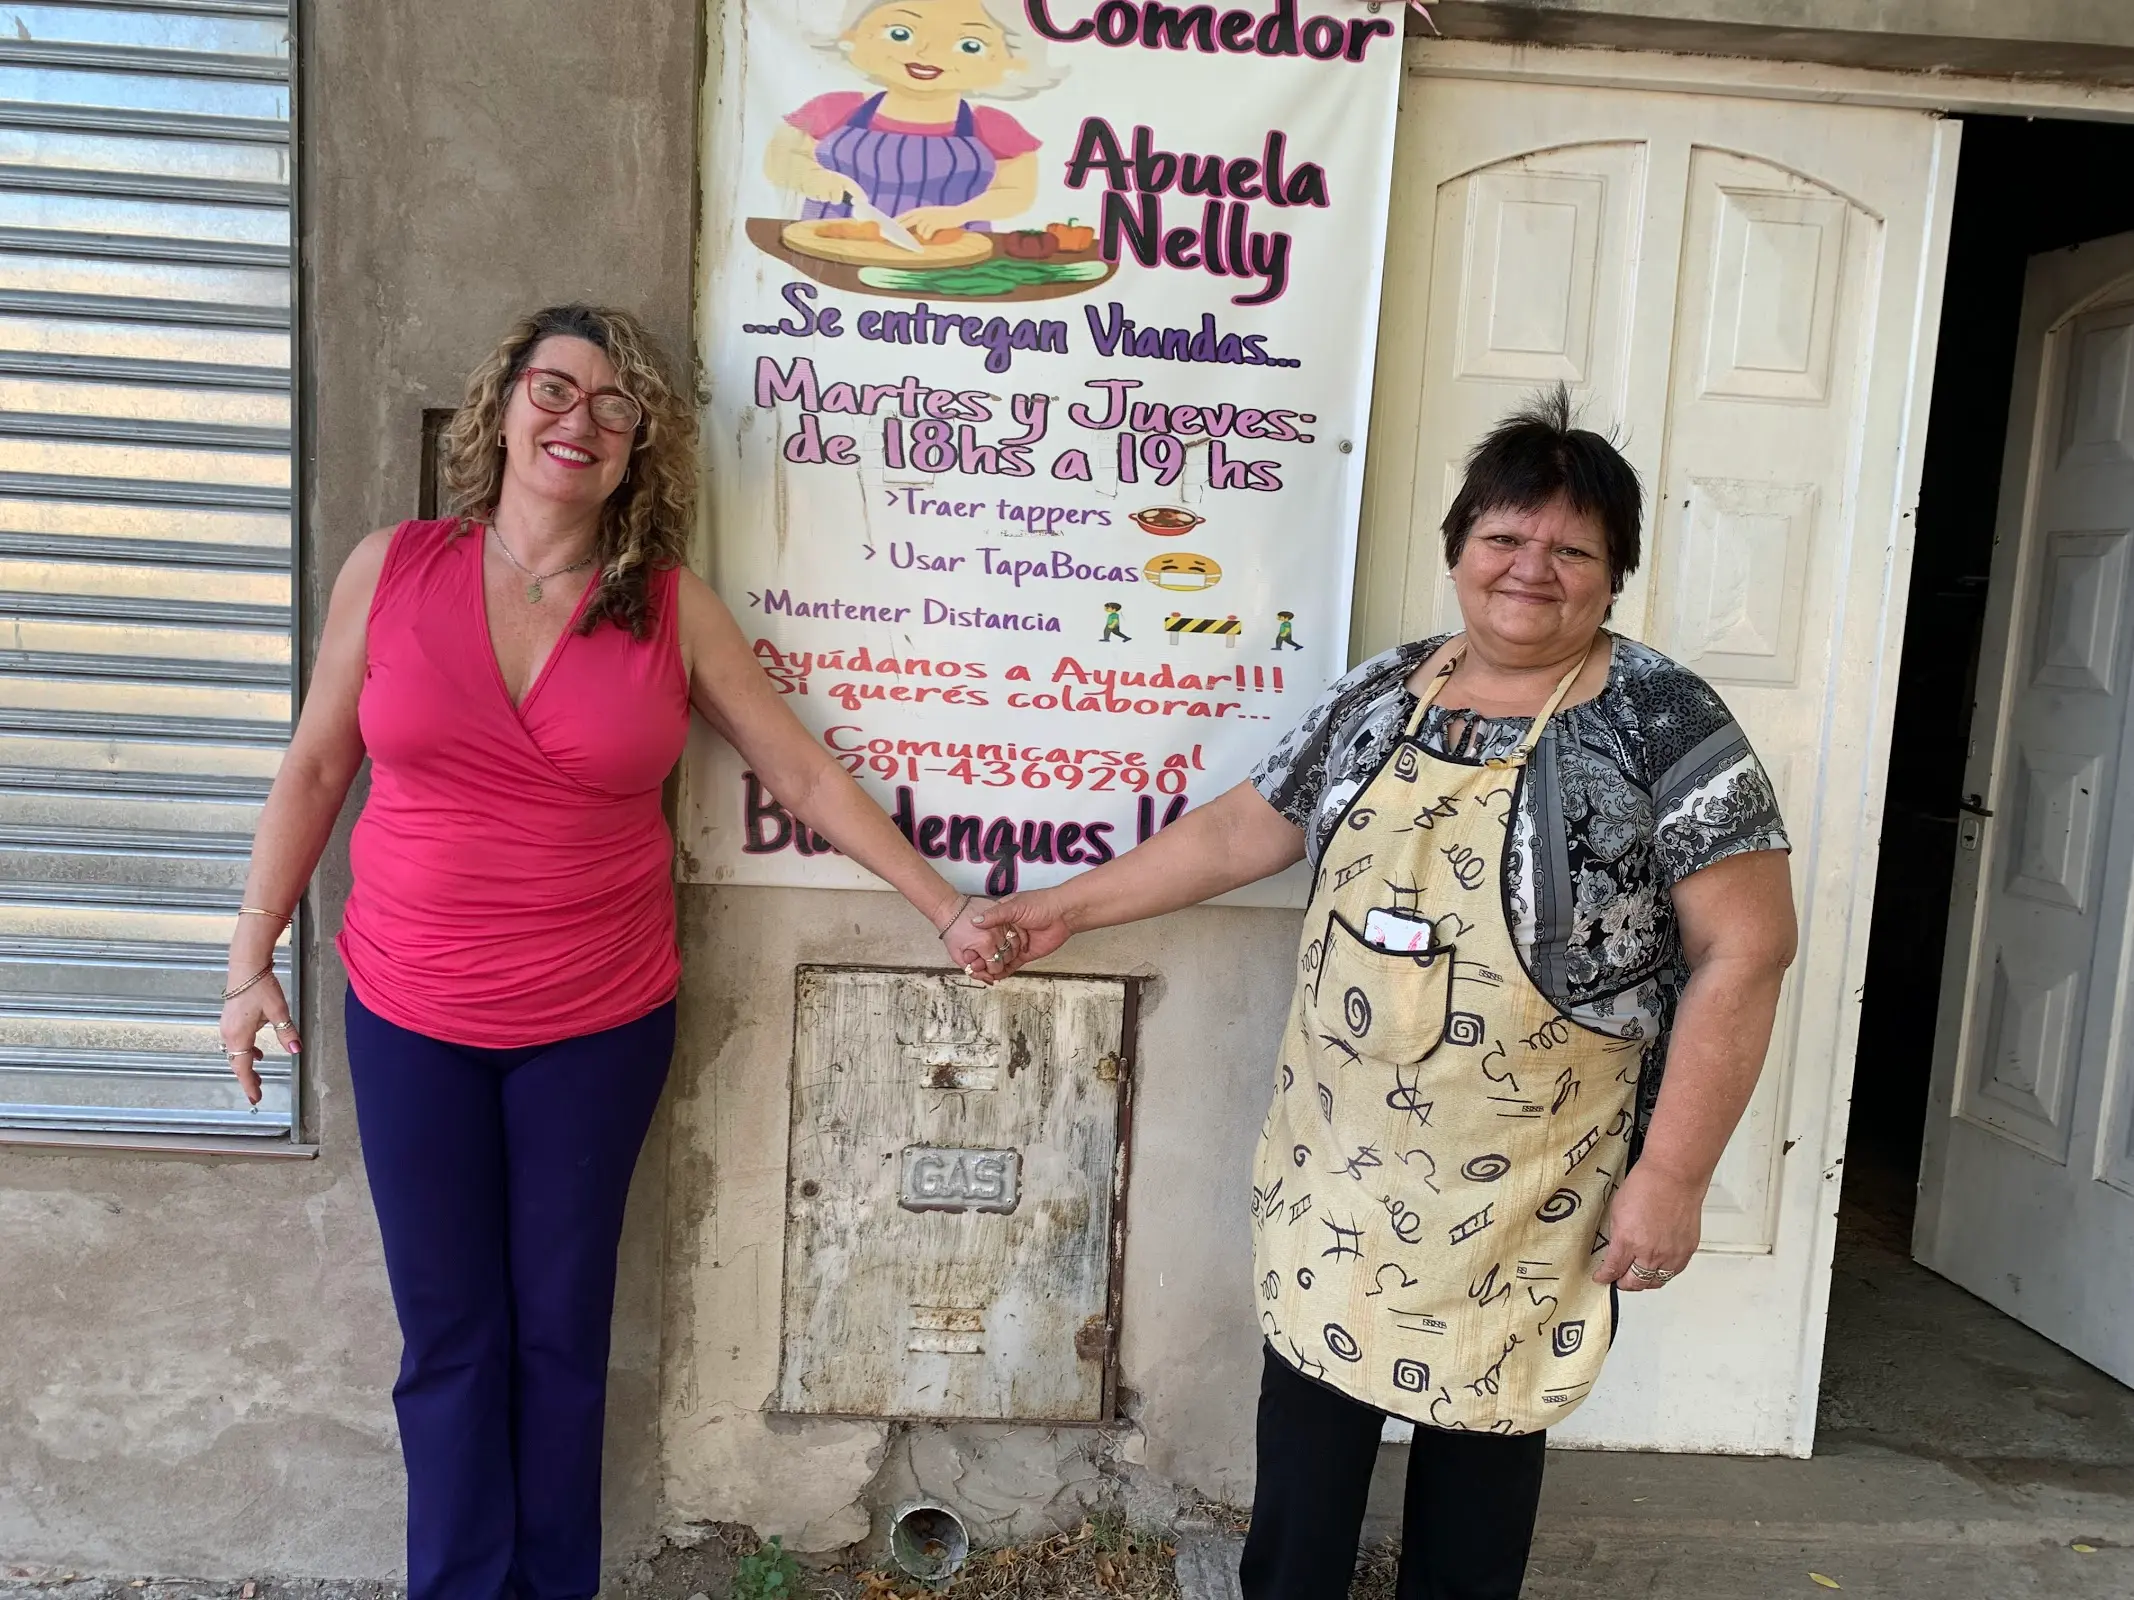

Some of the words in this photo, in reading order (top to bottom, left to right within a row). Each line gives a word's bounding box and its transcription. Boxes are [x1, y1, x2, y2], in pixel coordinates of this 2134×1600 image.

[1063, 116, 1330, 208] Abuela
[1098, 189, 1292, 306] Nelly
[857, 302, 1068, 373] entregan
[1084, 302, 1301, 368] Viandas...
[754, 356, 992, 422] Martes
[1000, 393, 1051, 446] y
[1068, 378, 1317, 443] Jueves:
[783, 413, 860, 465] de
[883, 416, 1036, 478] 18hs
[1050, 449, 1093, 481] a
[1117, 432, 1186, 487] 19
[1208, 440, 1283, 492] hs
[996, 499, 1112, 534] tappers
[890, 541, 966, 572] Usar
[975, 547, 1140, 588] TapaBocas
[923, 598, 1062, 633] Distancia
[753, 638, 989, 680] Ayúdanos
[1004, 664, 1032, 682] a
[1051, 656, 1284, 698] Ayudar!!!
[764, 667, 809, 695] Si
[828, 682, 990, 711] querés
[1007, 685, 1271, 720] colaborar...
[823, 725, 1147, 767] Comunicarse
[1163, 744, 1206, 771] al
[836, 753, 1188, 795] 291-4369290
[912, 1156, 1006, 1199] GAS
